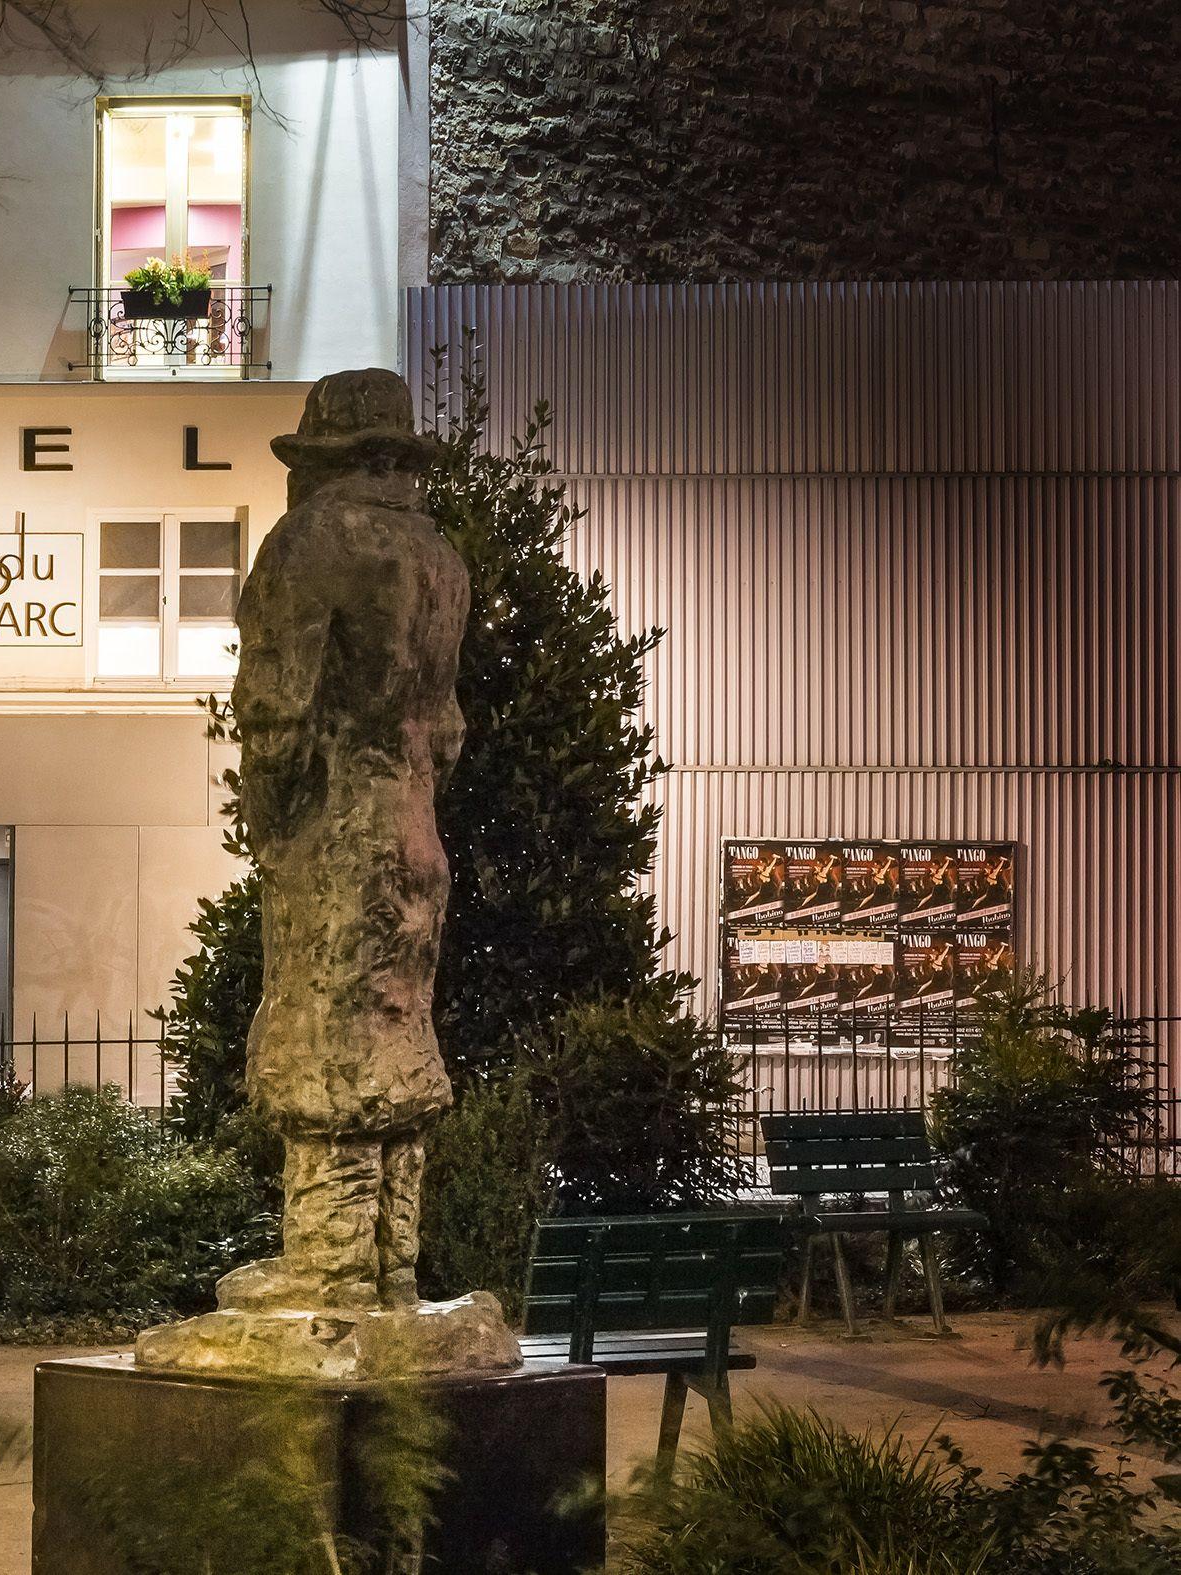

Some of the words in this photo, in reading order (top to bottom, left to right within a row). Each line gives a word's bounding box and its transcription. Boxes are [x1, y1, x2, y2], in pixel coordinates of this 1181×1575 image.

[728, 846, 759, 860] TANGO
[785, 846, 816, 860] TANGO
[842, 848, 873, 862] TANGO
[900, 848, 932, 862] TANGO
[956, 848, 986, 862] TANGO
[901, 934, 932, 948] TANGO
[955, 933, 987, 948] TANGO
